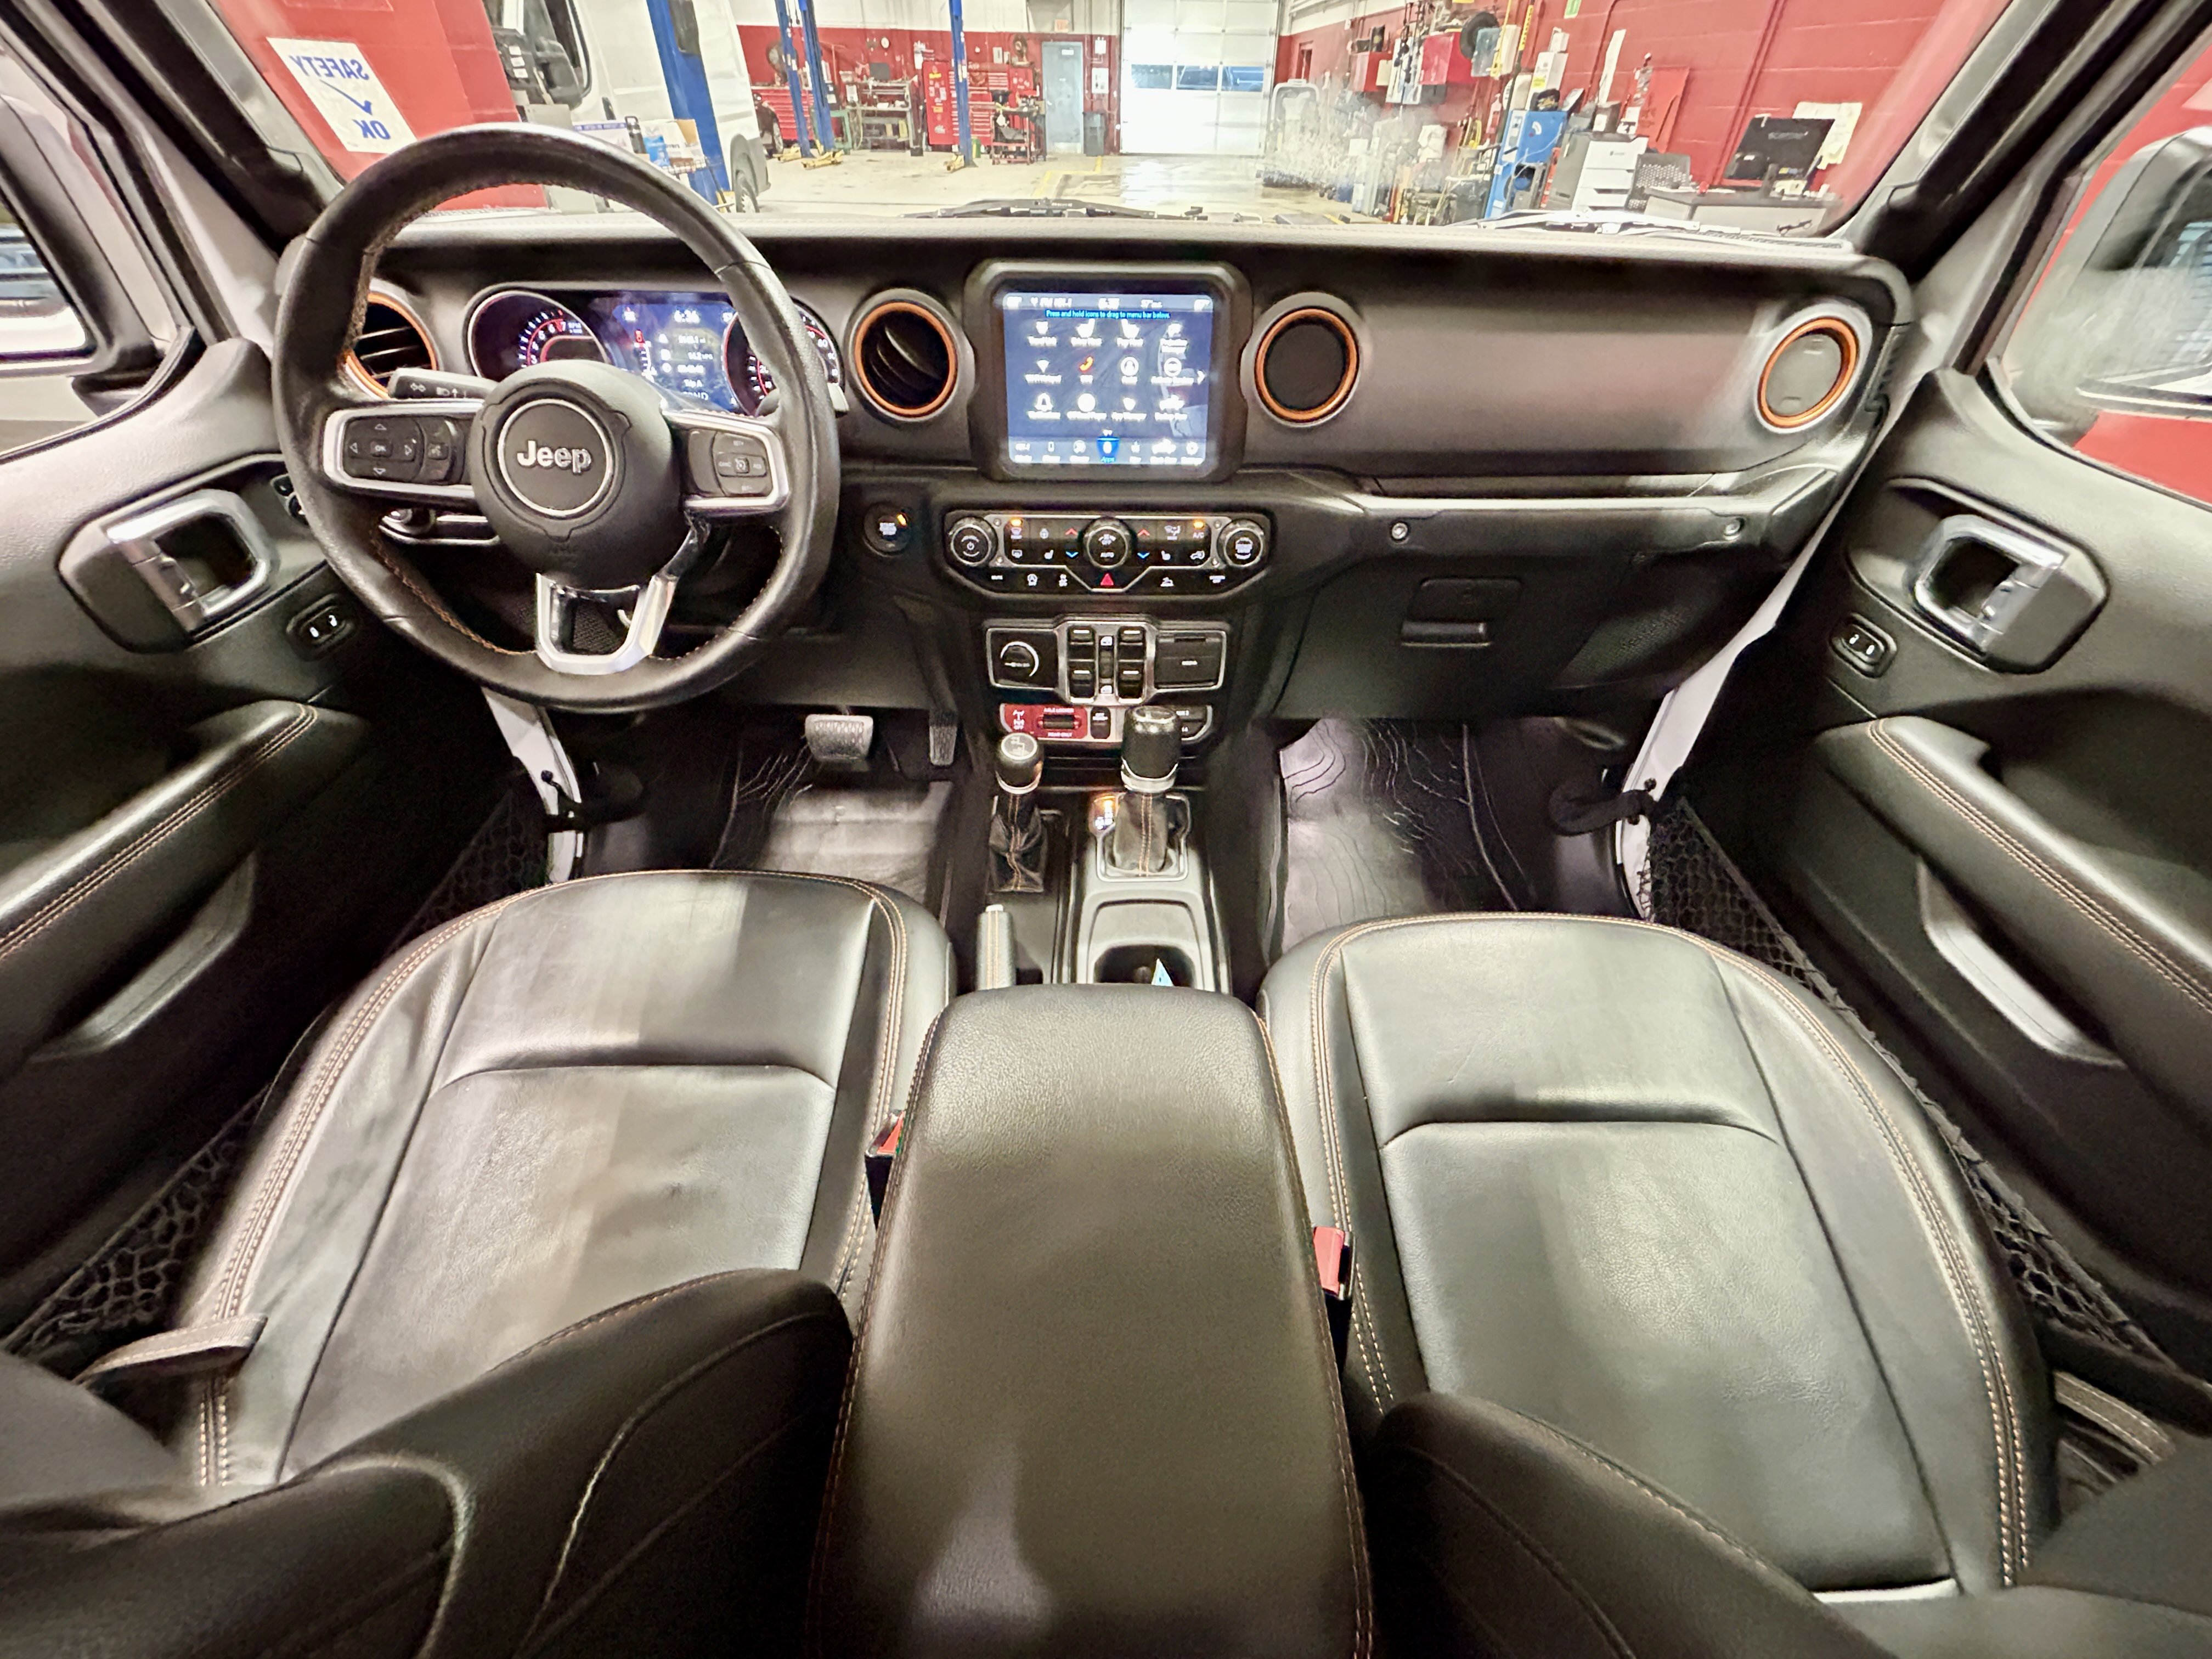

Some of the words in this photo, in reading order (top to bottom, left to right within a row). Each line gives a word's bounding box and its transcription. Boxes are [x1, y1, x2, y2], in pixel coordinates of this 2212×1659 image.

[1107, 311, 1119, 319] drag
[548, 324, 556, 334] 6
[560, 321, 566, 331] 7
[538, 330, 546, 340] 5
[532, 341, 539, 351] 4
[531, 354, 538, 364] 3
[696, 379, 703, 388] A
[517, 440, 592, 474] Jeep
